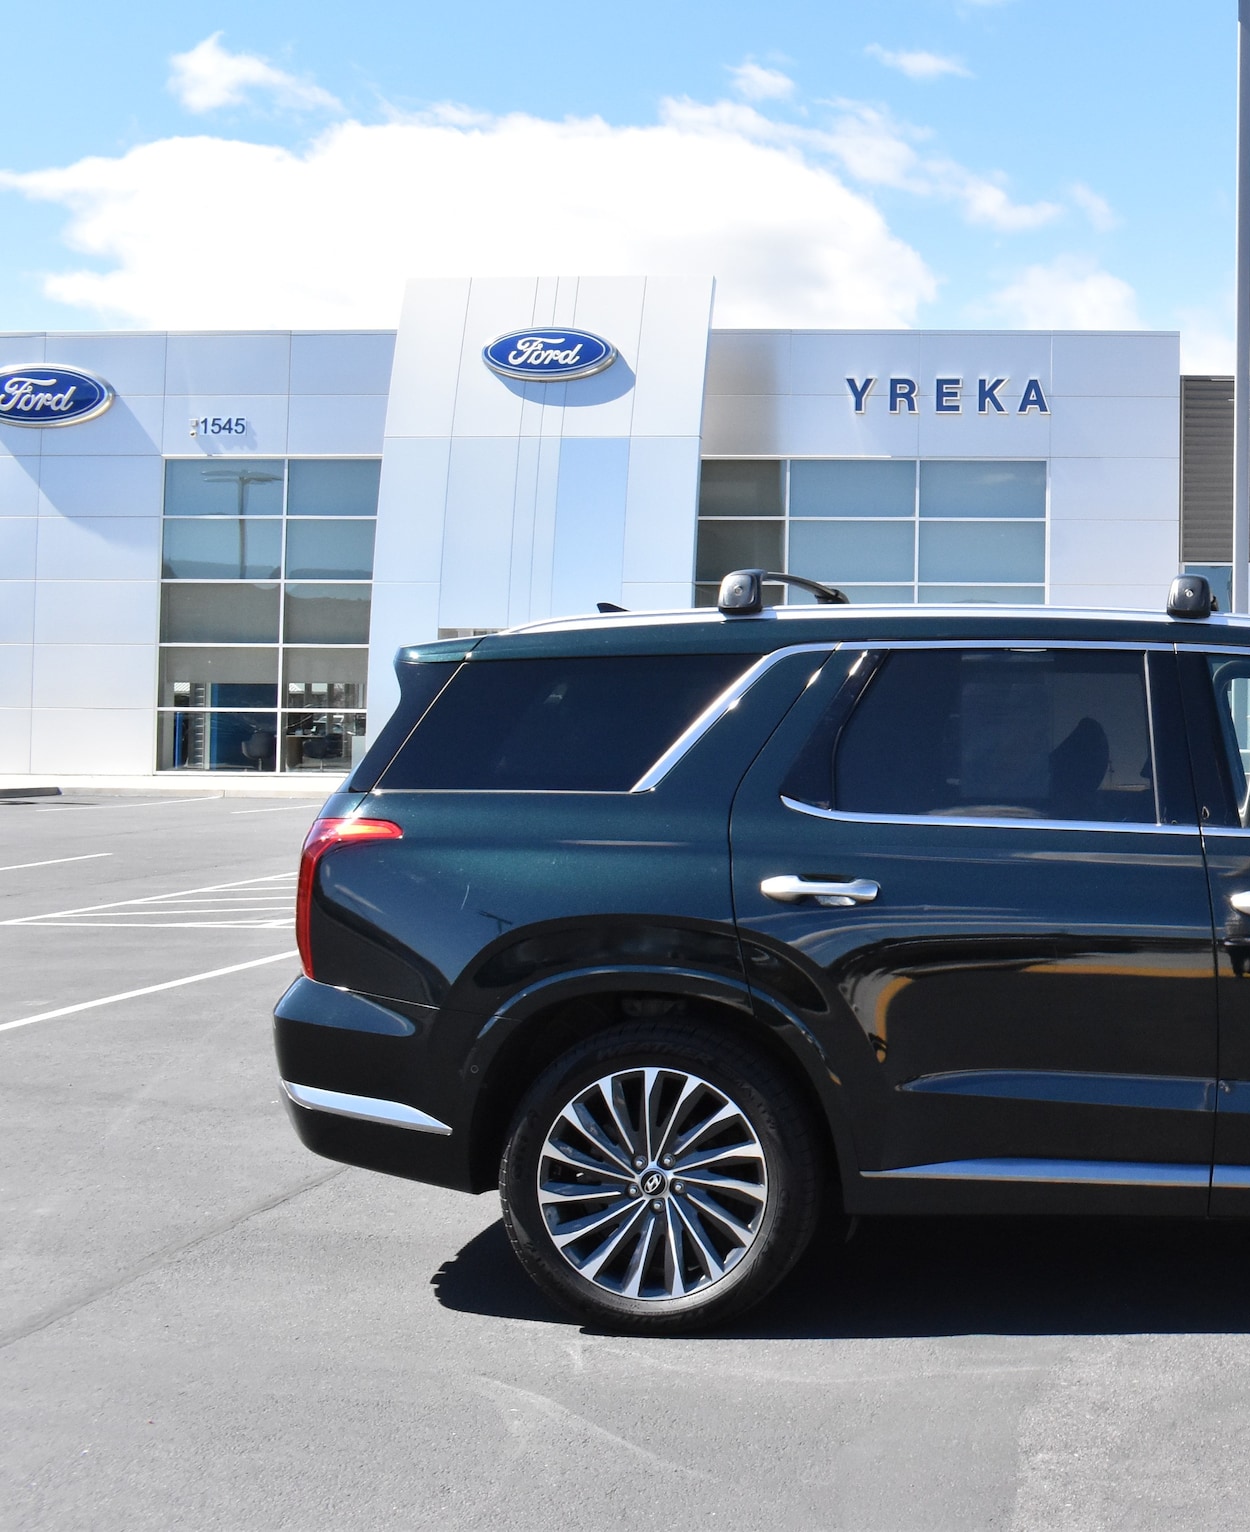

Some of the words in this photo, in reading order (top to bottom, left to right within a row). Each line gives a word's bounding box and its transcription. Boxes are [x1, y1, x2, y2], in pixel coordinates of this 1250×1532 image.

[508, 336, 583, 365] Ford
[0, 377, 76, 411] Ford
[845, 377, 1051, 414] YREKA
[201, 417, 246, 435] 1545
